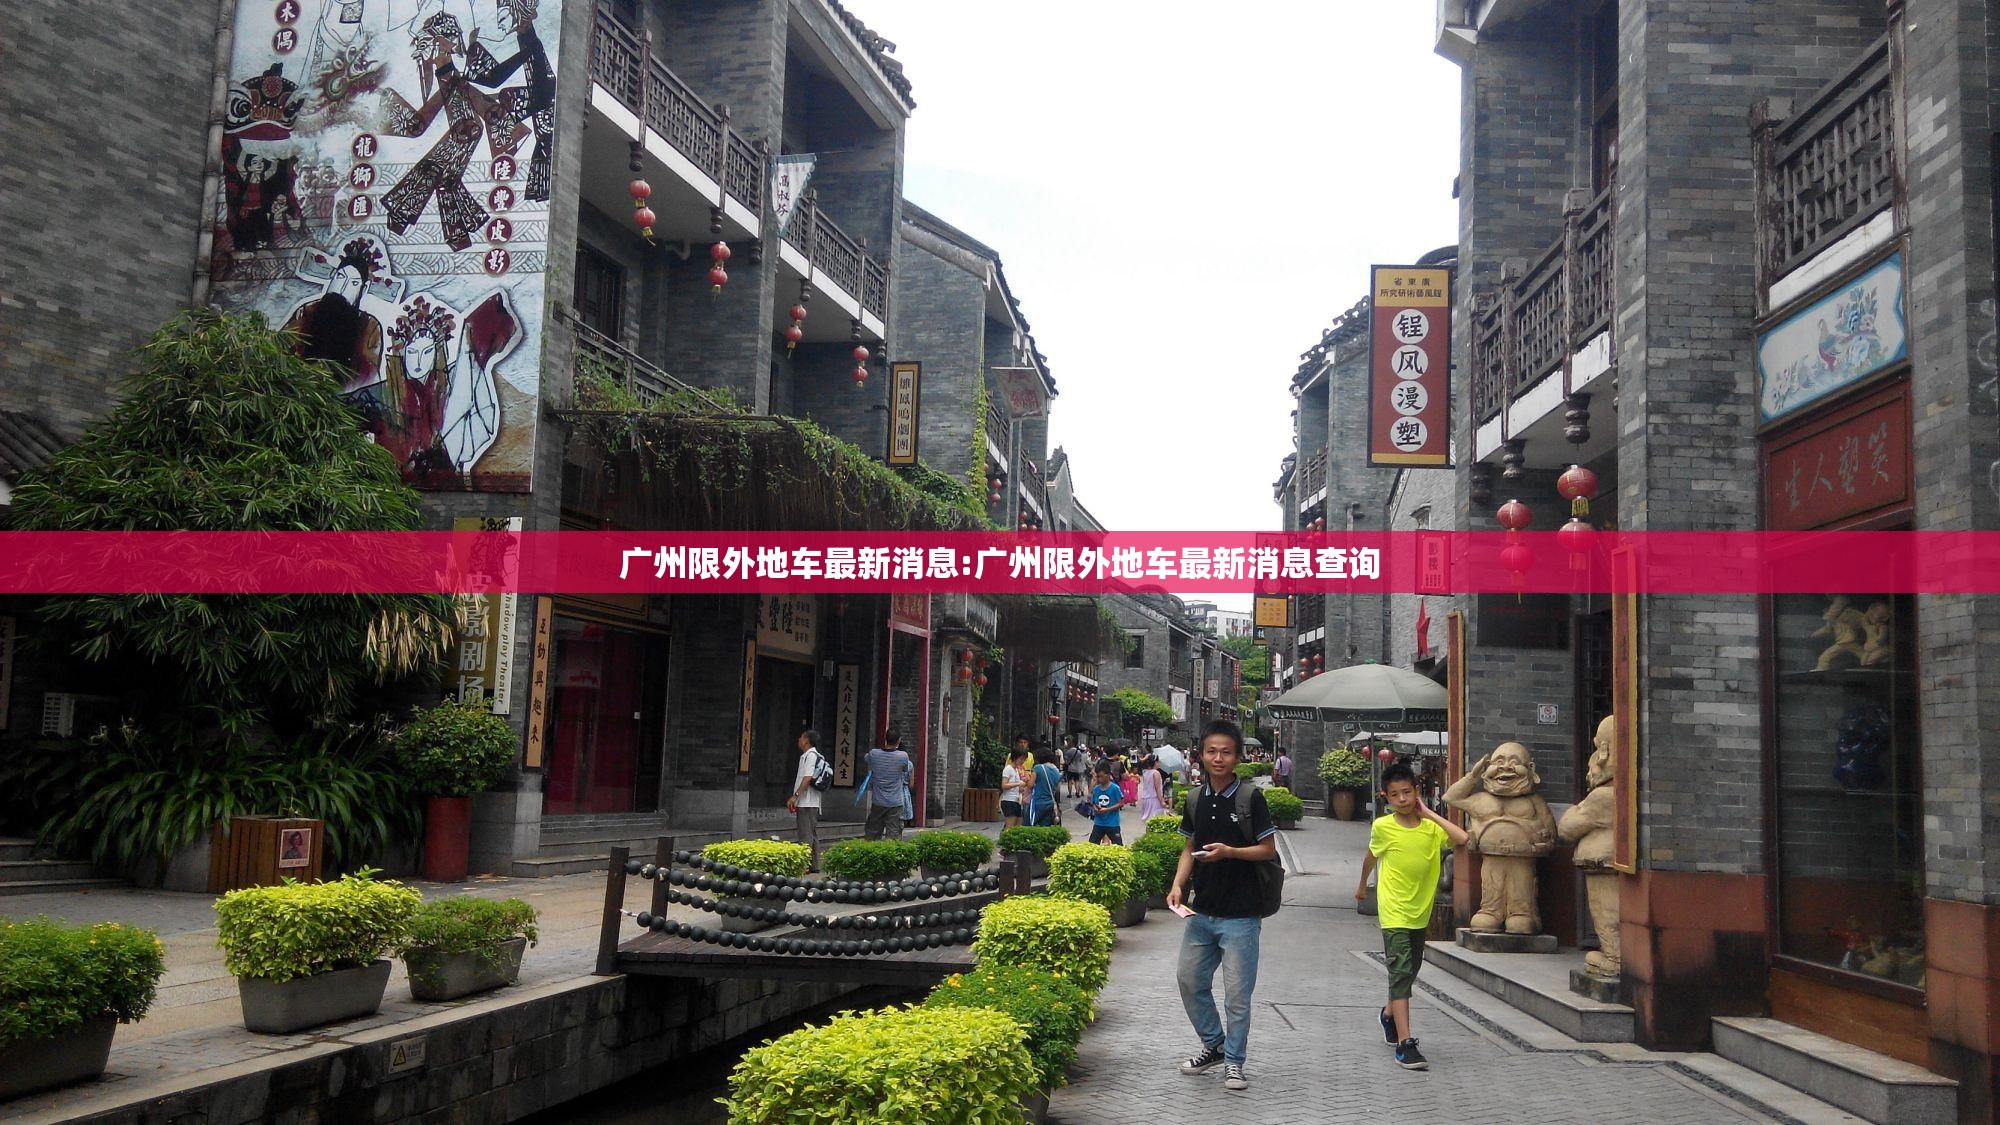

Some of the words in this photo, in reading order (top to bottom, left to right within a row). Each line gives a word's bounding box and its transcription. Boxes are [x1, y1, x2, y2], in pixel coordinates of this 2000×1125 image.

[276, 2, 297, 50] 木偶
[353, 137, 374, 217] 龍獅匯
[488, 160, 511, 273] 陸豐皮影
[503, 589, 512, 633] Shadow
[500, 633, 509, 658] play
